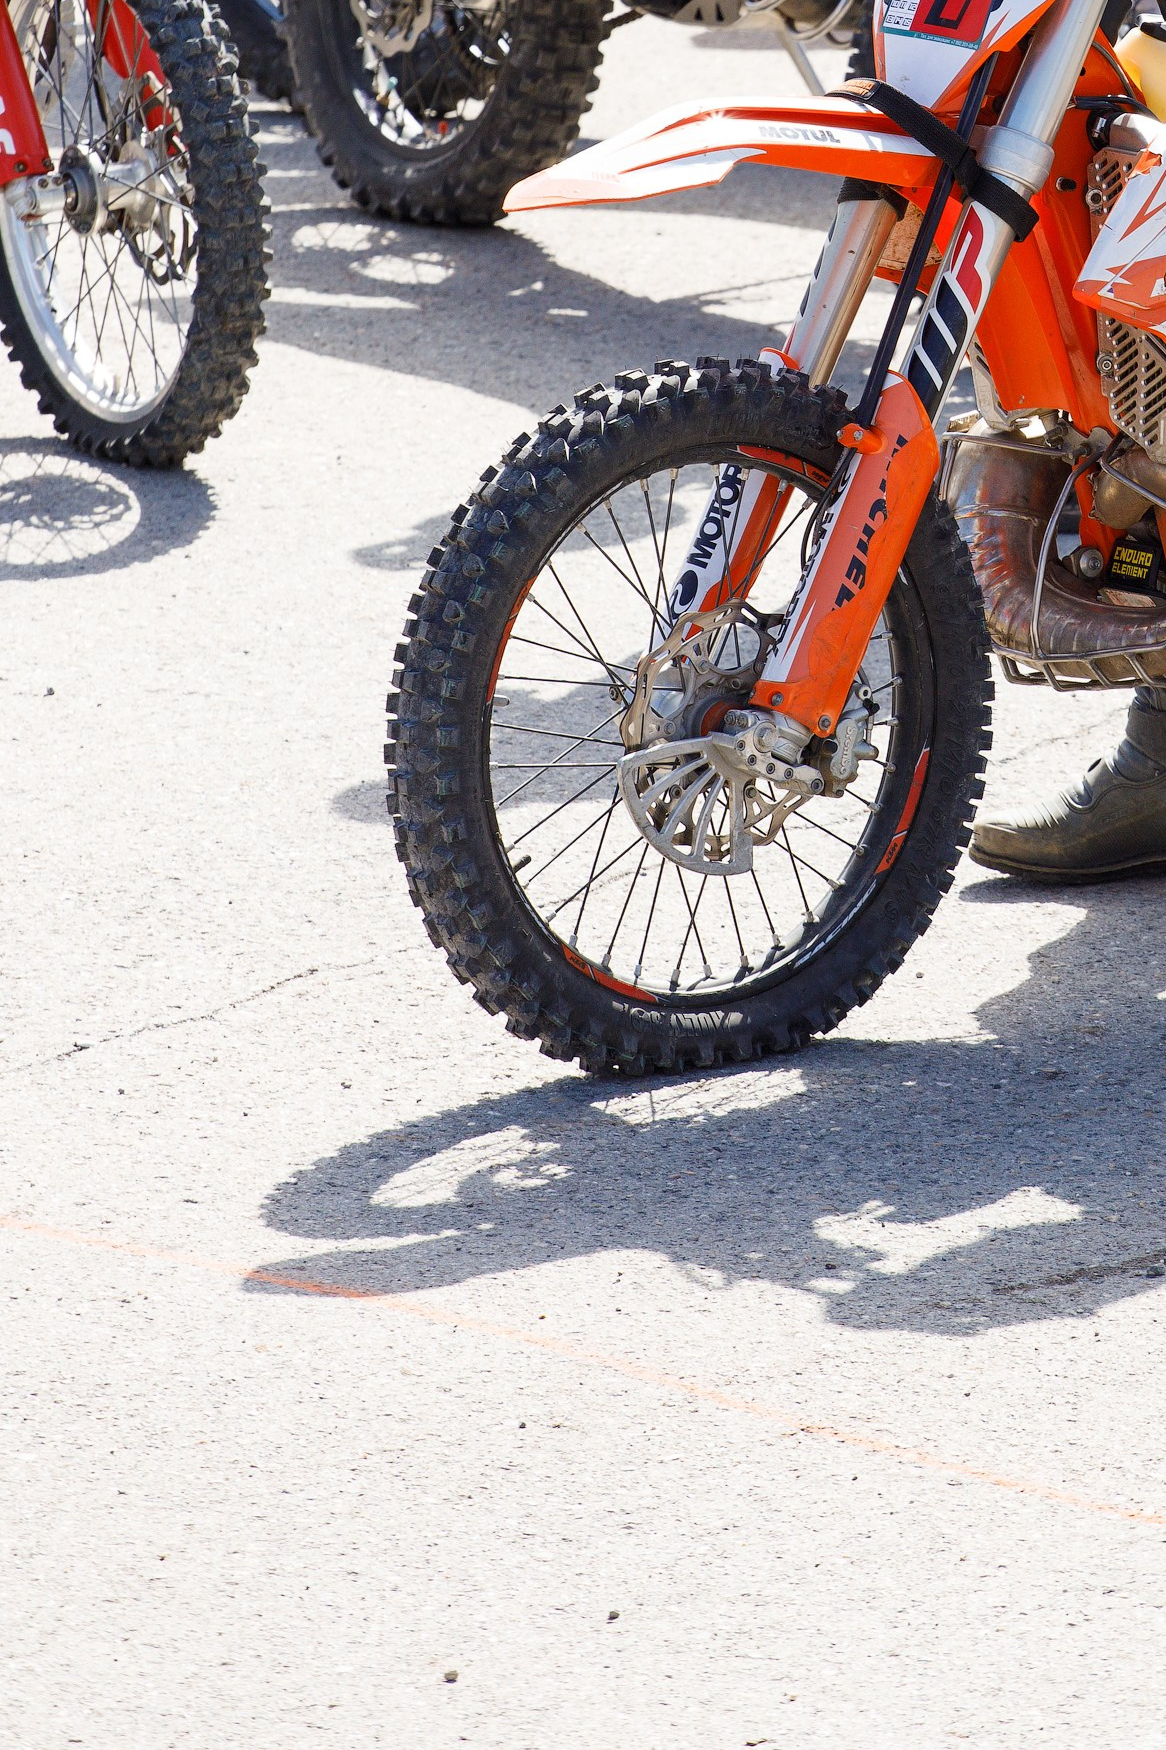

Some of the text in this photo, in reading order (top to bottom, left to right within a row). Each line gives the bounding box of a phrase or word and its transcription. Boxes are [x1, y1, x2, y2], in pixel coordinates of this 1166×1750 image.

[758, 126, 840, 144] MOTUL
[686, 462, 744, 566] MOTOR
[1114, 546, 1153, 567] ENDURO
[1112, 562, 1148, 580] ELEMENT
